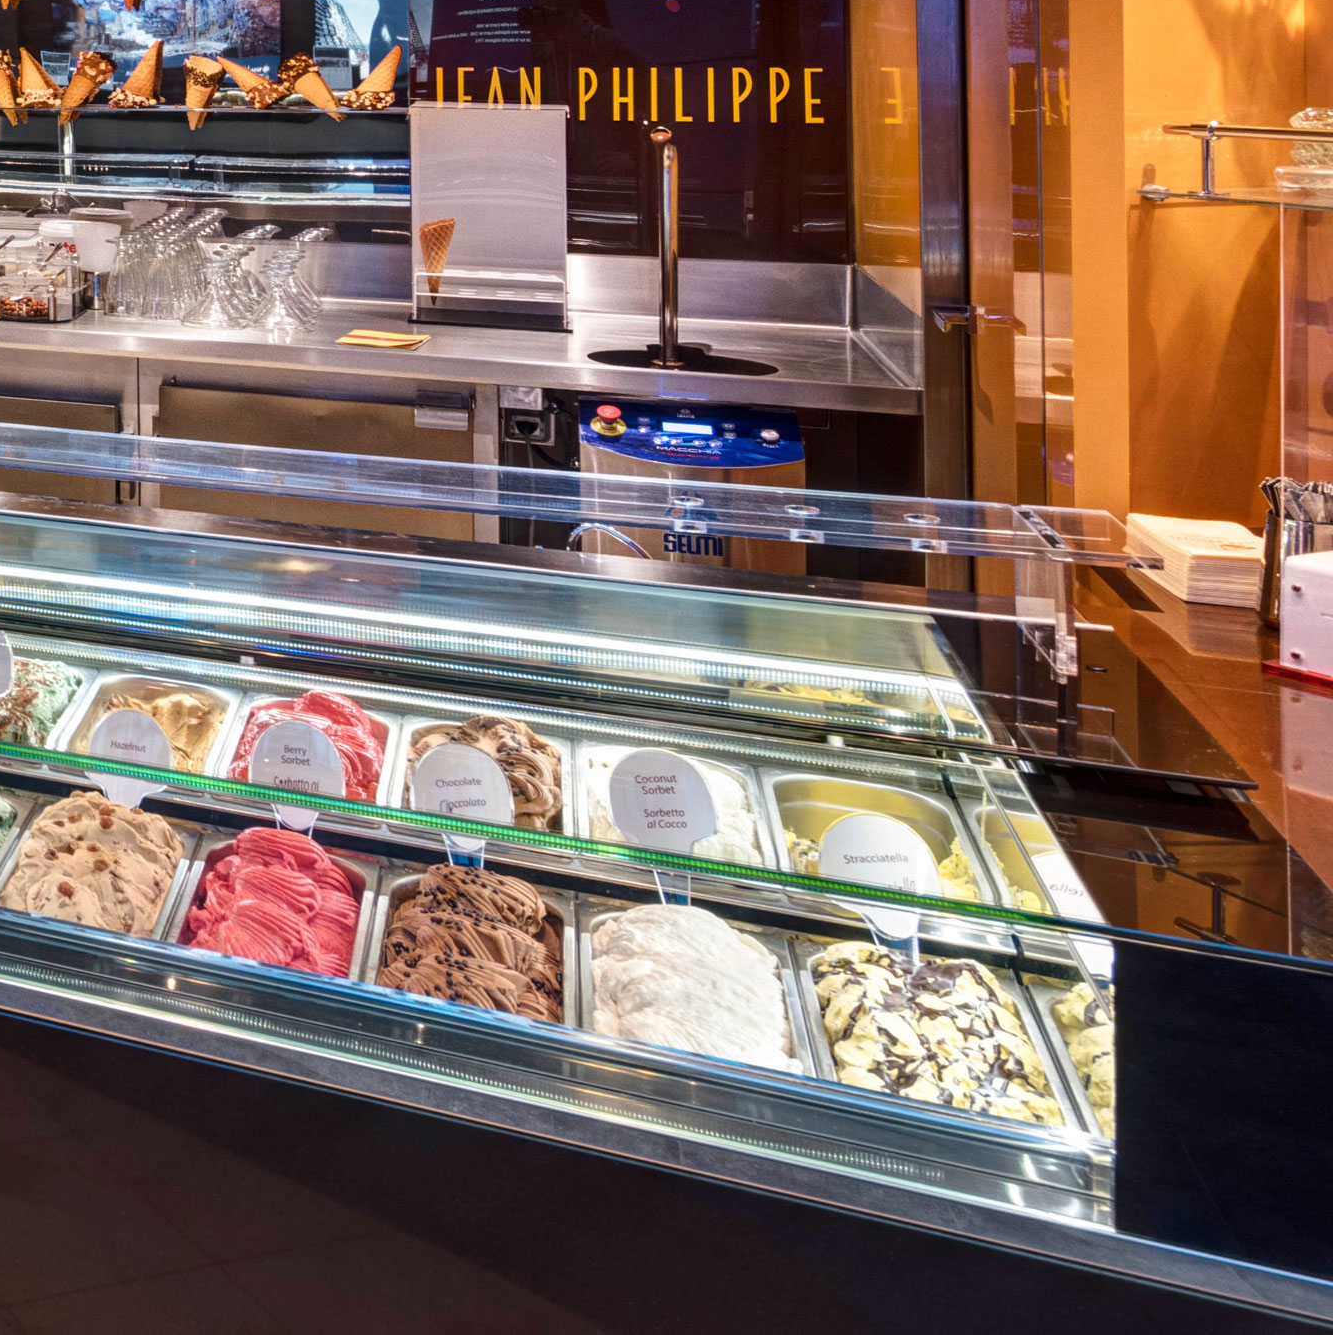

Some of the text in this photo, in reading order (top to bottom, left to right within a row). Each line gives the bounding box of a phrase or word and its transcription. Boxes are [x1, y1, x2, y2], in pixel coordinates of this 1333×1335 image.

[578, 67, 825, 124] PHILIPPE
[663, 533, 724, 557] SELMI
[110, 740, 146, 753] Hazelnut
[283, 744, 307, 756] Berry
[281, 755, 310, 766] Sorbet
[435, 777, 482, 787] Chocolate
[635, 774, 677, 784] Coconut
[642, 785, 675, 795] Sorbet
[643, 809, 685, 818] Sorbetto
[646, 820, 687, 829] al Cocco
[843, 854, 909, 864] Stracciatella
